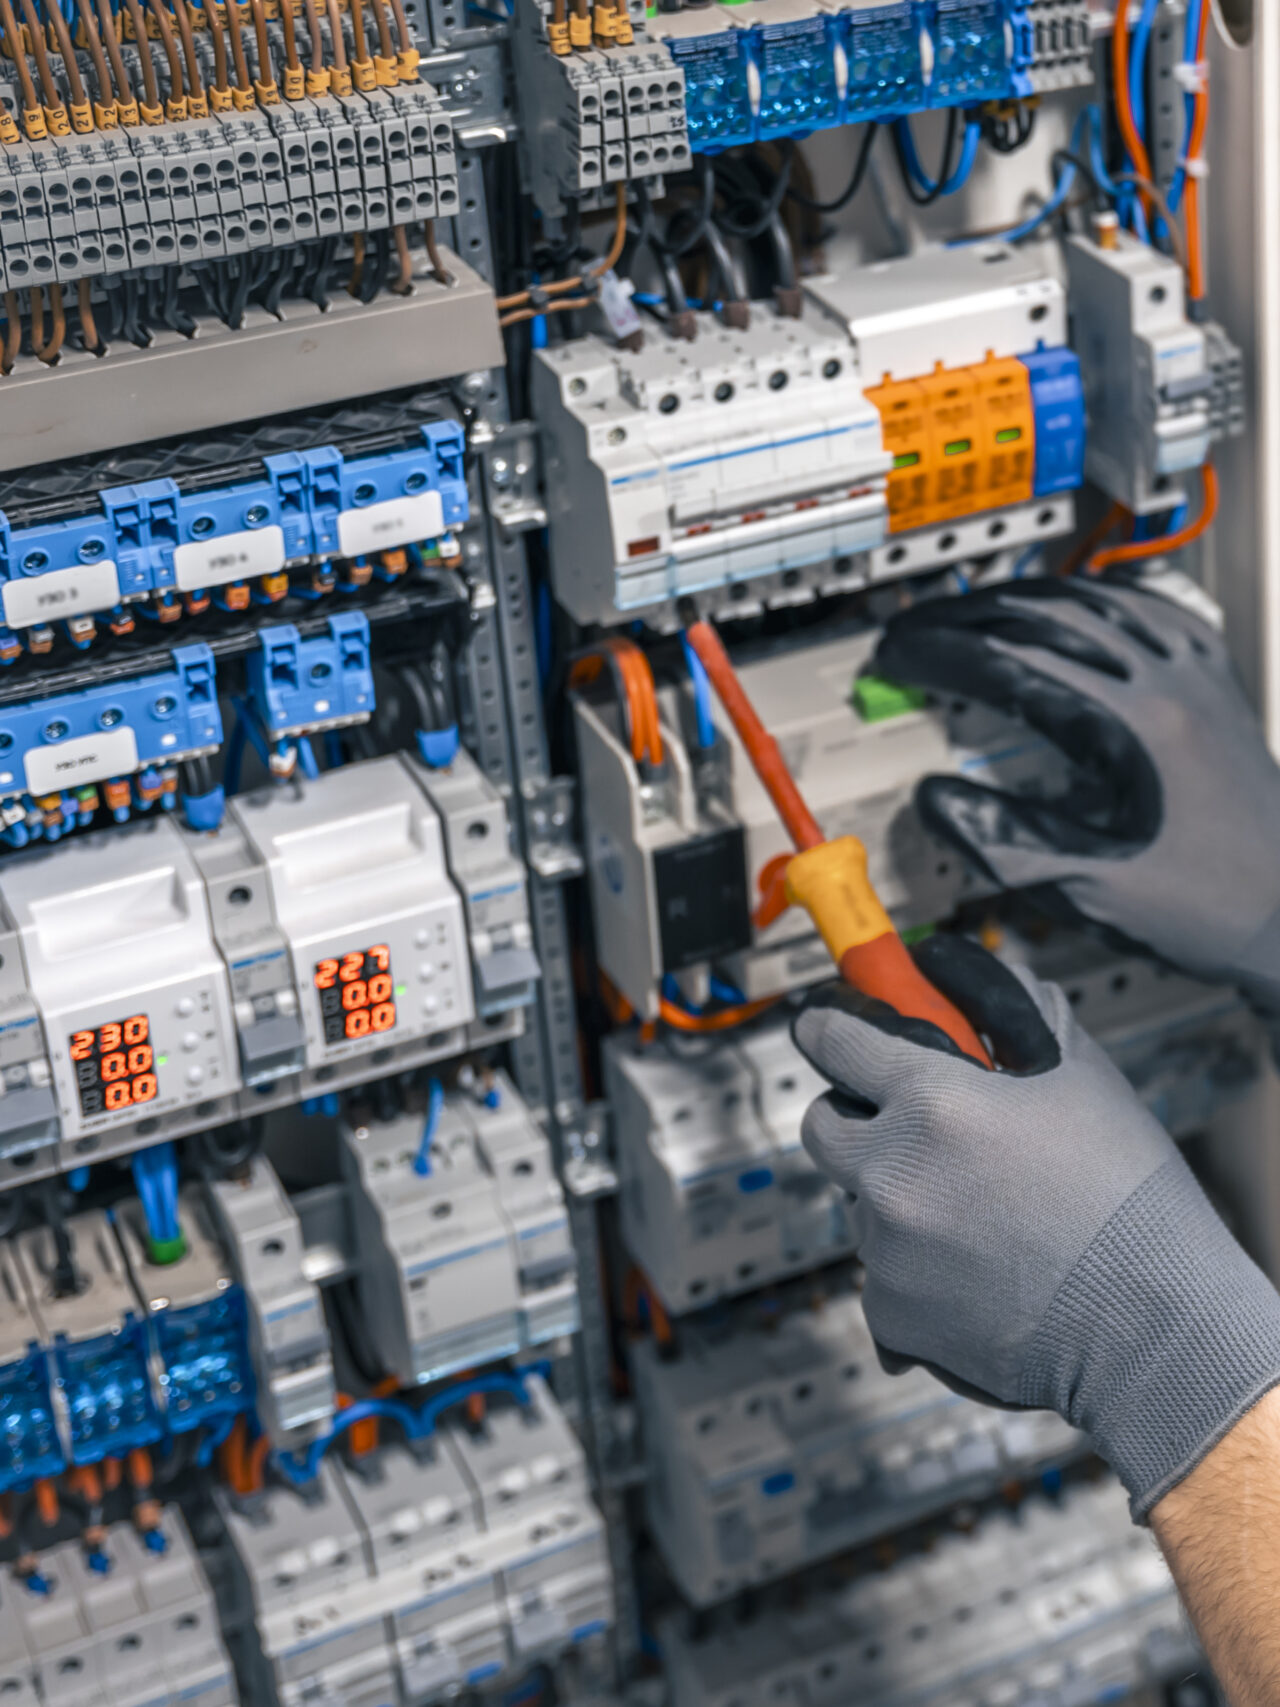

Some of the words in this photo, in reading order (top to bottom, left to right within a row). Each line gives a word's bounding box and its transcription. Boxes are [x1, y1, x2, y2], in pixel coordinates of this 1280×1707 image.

[1, 116, 16, 141] 18
[28, 114, 44, 136] 19
[53, 110, 69, 131] 20
[76, 111, 89, 128] 21
[103, 109, 118, 130] 22
[314, 944, 390, 989] 227
[70, 1014, 150, 1061] 230
